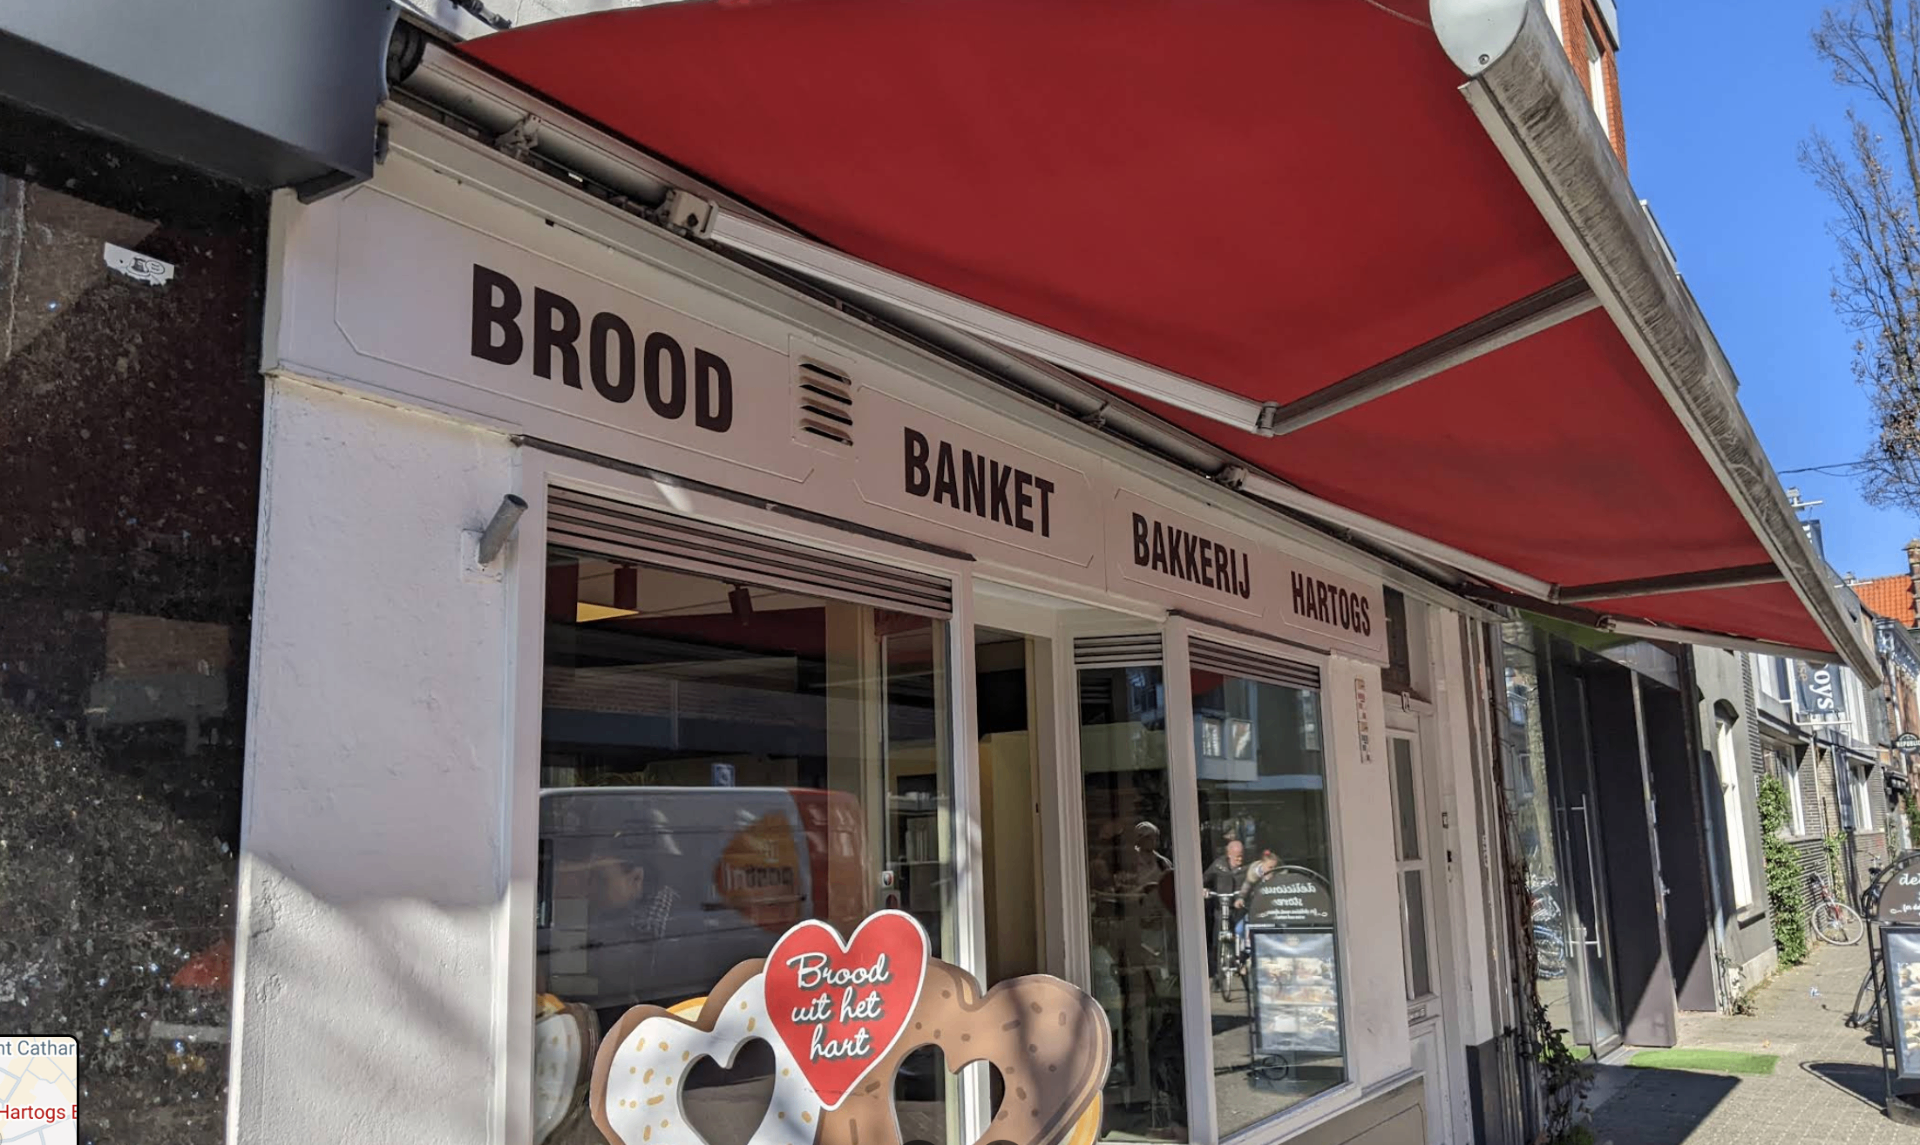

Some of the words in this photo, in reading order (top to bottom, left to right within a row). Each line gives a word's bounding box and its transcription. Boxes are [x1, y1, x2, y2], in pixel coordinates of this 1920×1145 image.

[471, 263, 733, 433] BROOD
[904, 426, 1055, 538] BANKET
[1132, 511, 1252, 600] BAKKERIJ
[1291, 570, 1372, 637] HARTOGS
[786, 952, 890, 989] Brood
[791, 992, 832, 1022] uit
[839, 986, 881, 1022] het
[809, 1023, 871, 1061] hart
